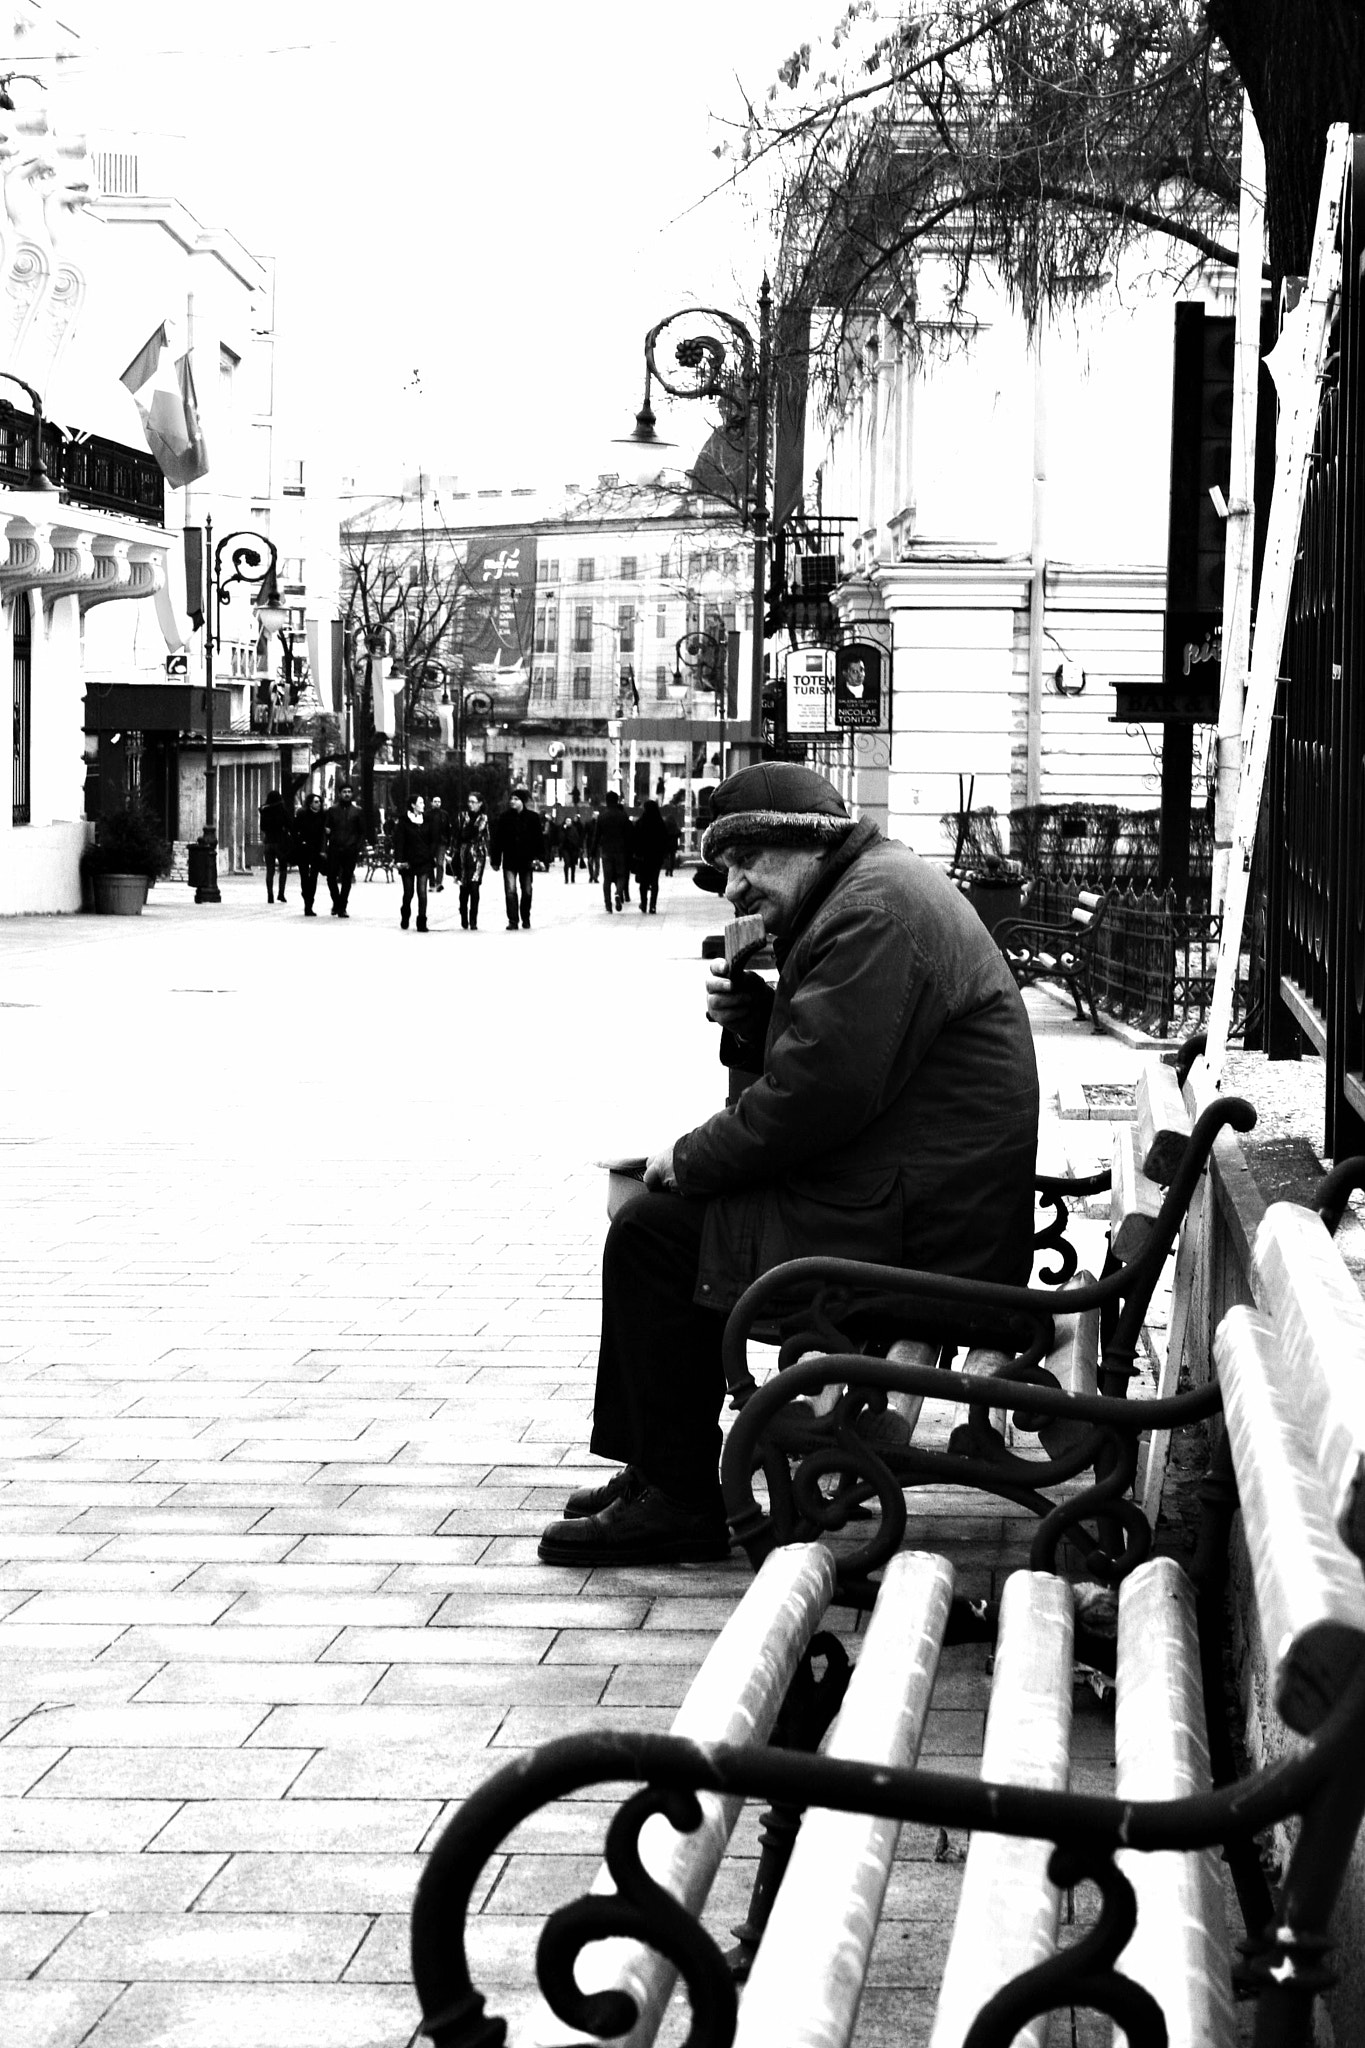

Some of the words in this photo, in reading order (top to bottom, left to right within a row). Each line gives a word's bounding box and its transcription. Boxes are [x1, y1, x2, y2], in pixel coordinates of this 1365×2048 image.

[794, 676, 835, 686] TOTEM
[794, 687, 836, 695] TURISM
[838, 716, 878, 724] TONITZA
